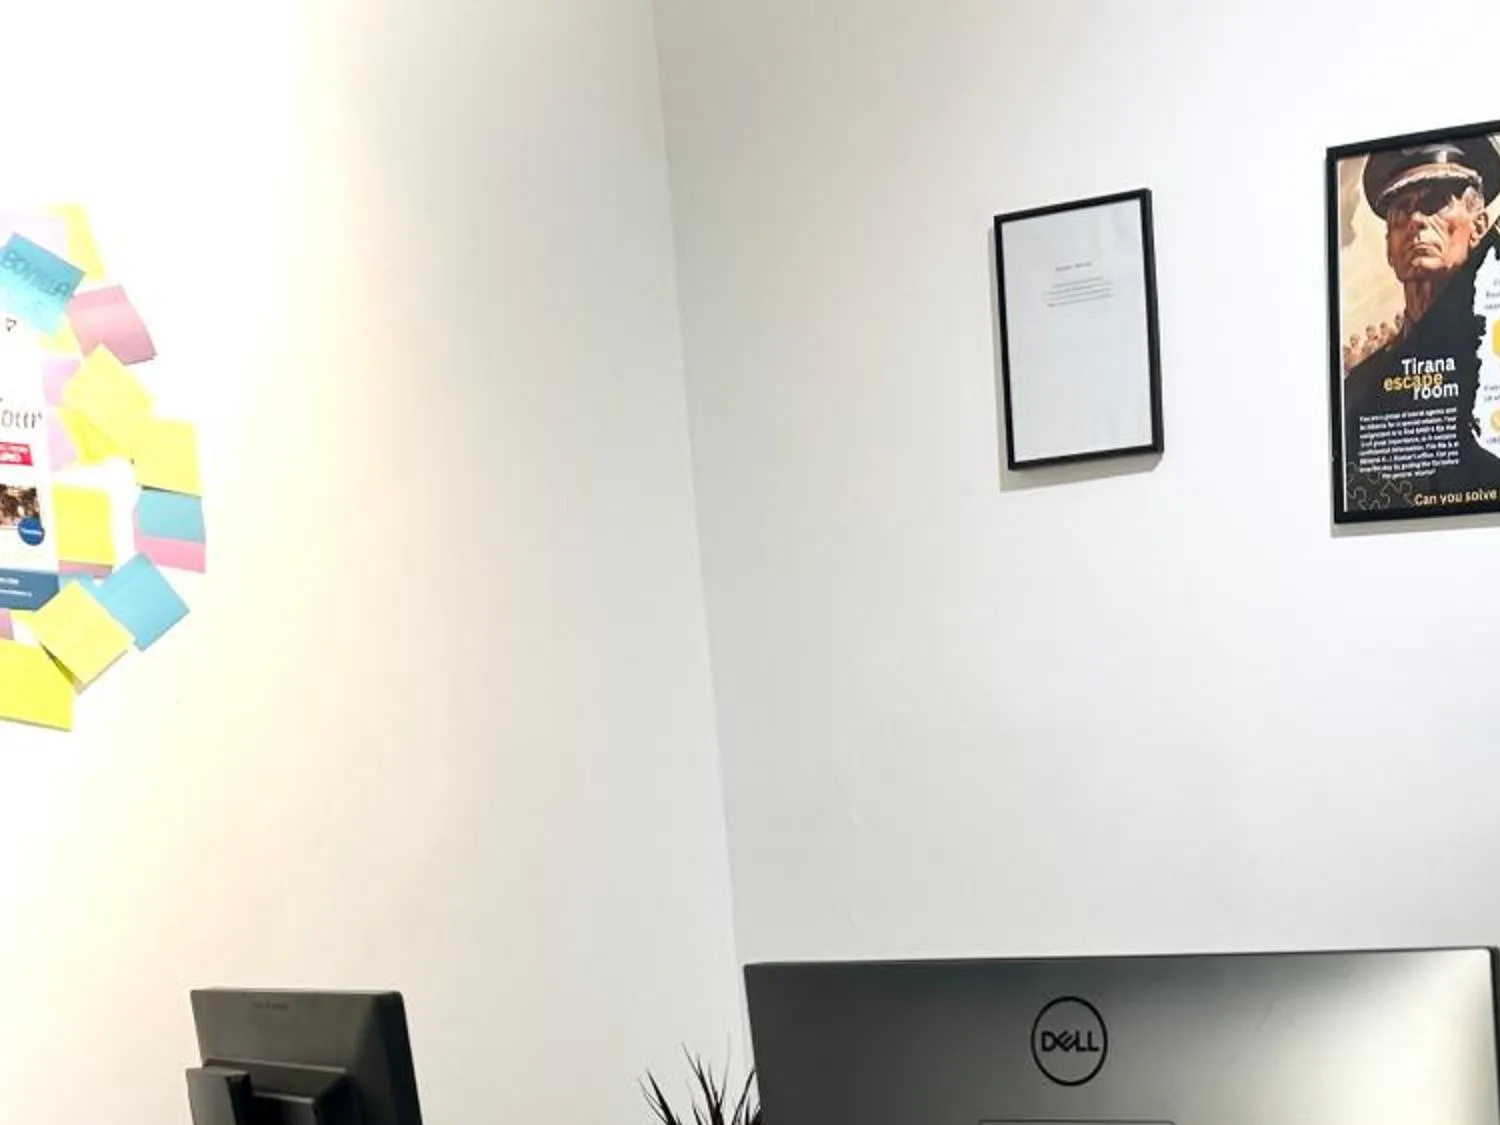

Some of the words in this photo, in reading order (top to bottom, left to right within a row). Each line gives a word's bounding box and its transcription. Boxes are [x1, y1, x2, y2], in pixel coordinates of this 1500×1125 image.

[1401, 357, 1456, 375] Tirana
[1383, 373, 1443, 391] escape
[1413, 383, 1459, 400] room
[1414, 493, 1437, 506] Can
[1440, 492, 1463, 505] you
[1465, 488, 1497, 502] solve
[1041, 1031, 1100, 1052] DELL
